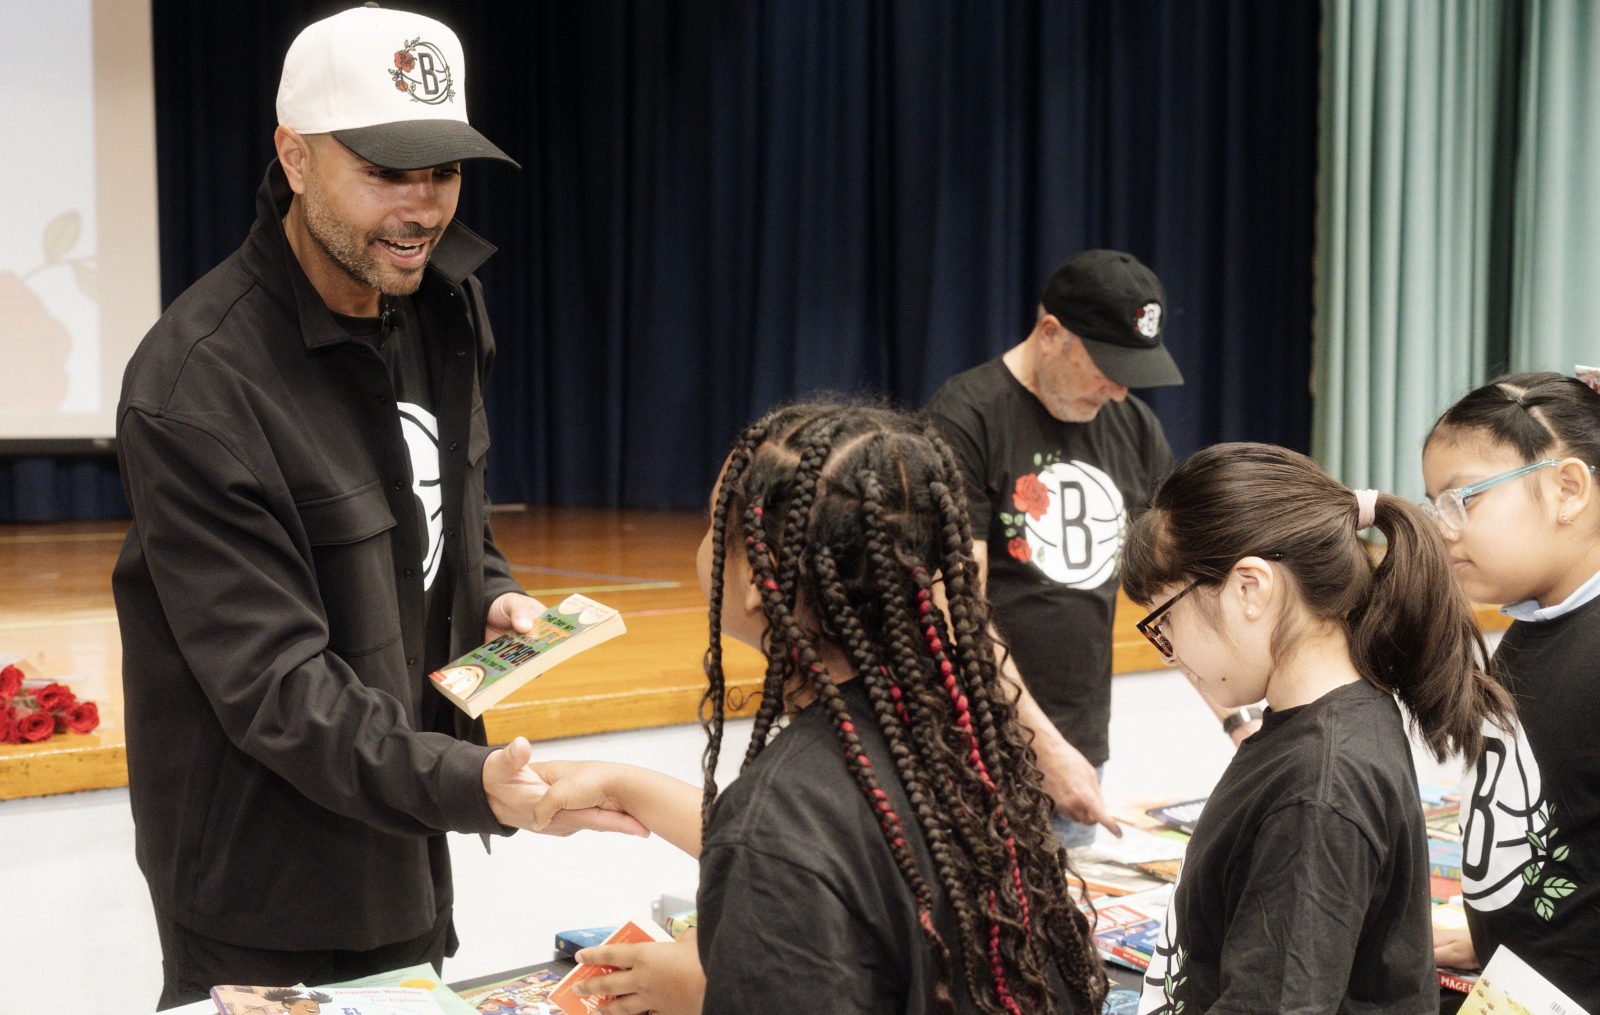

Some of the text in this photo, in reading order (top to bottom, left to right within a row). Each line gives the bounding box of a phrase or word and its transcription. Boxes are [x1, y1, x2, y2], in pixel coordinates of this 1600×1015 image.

[418, 52, 439, 95] B
[1060, 481, 1092, 570] B
[1462, 736, 1507, 882] B
